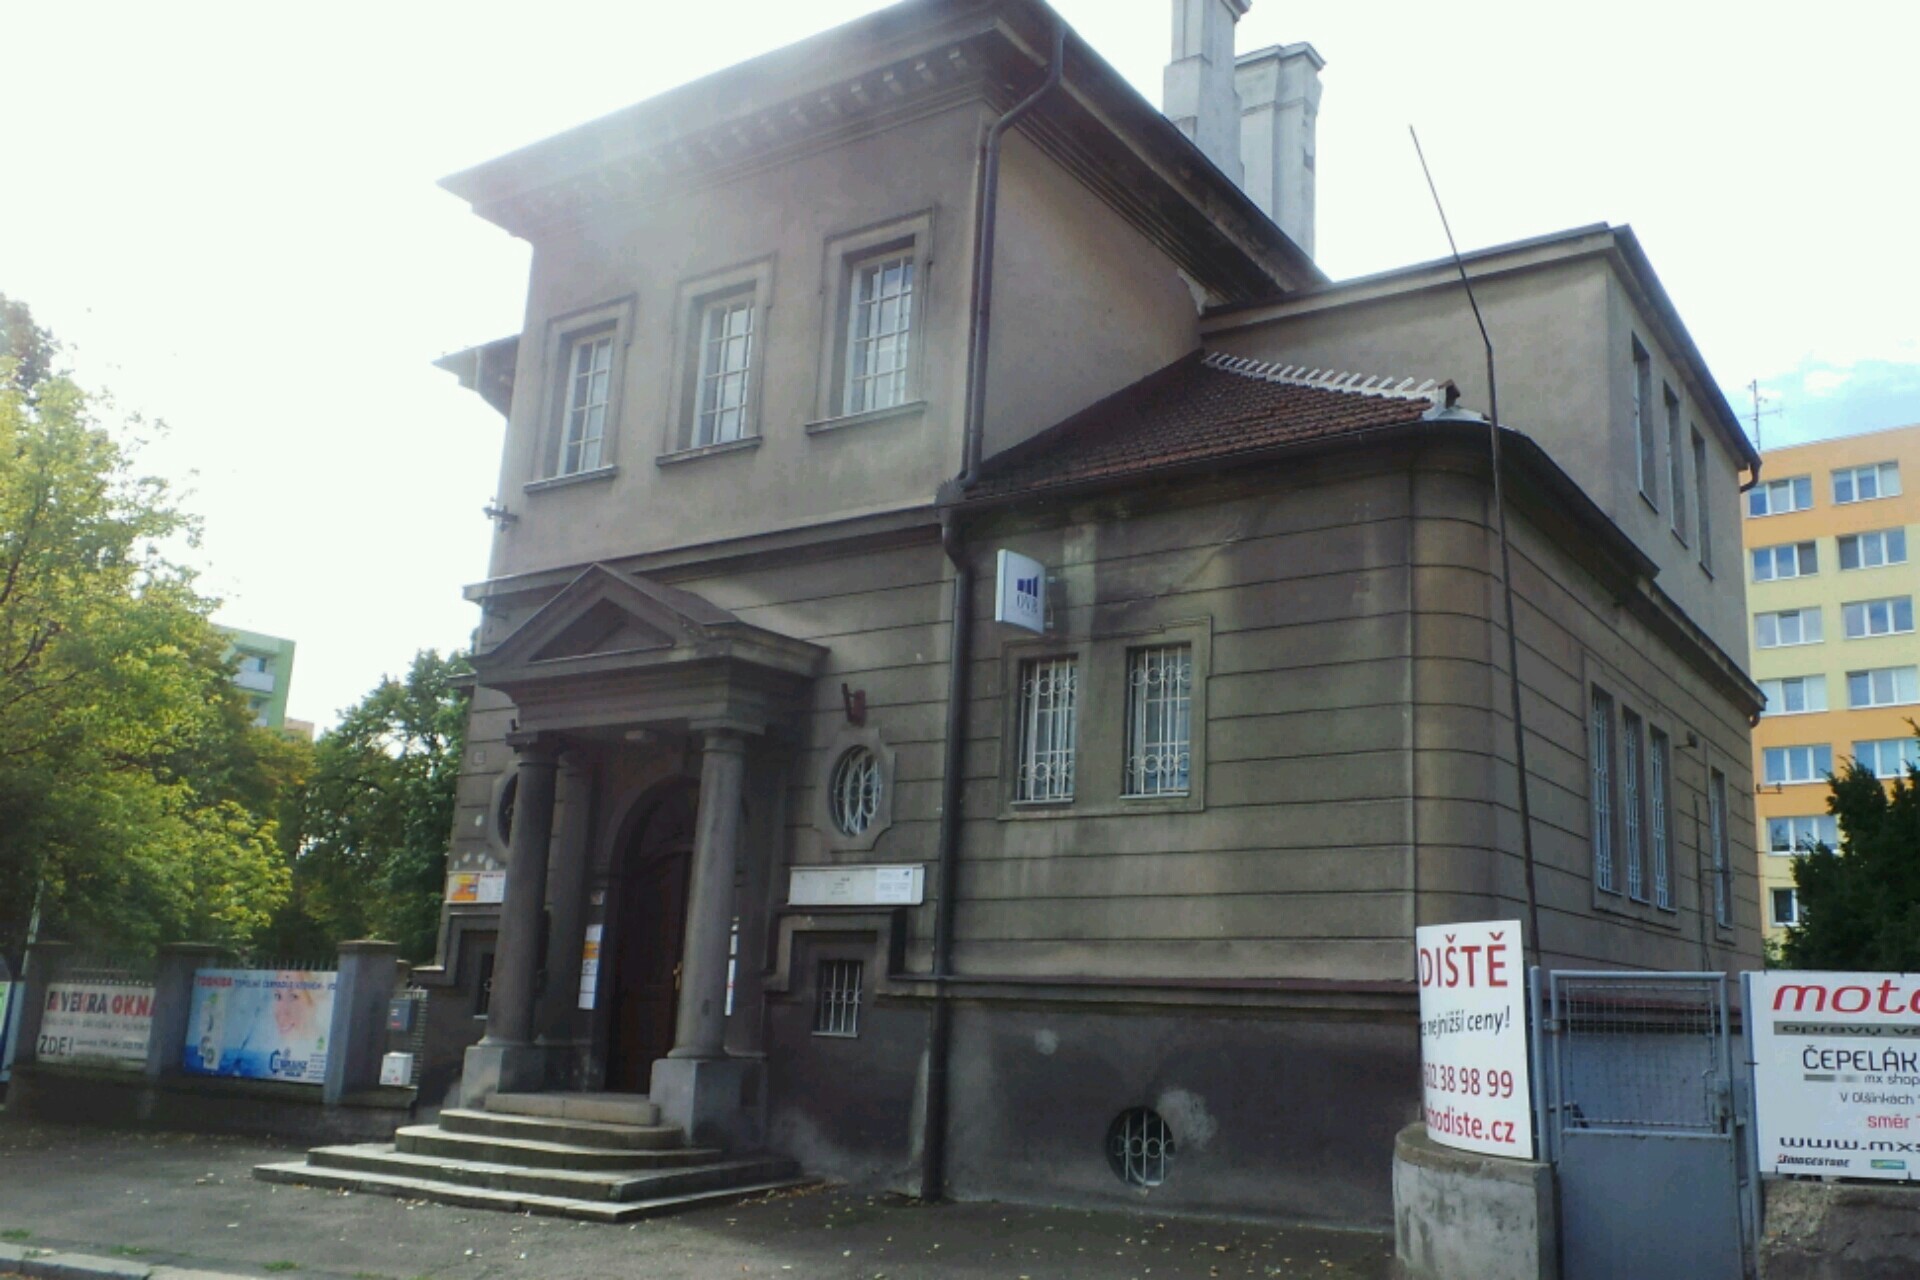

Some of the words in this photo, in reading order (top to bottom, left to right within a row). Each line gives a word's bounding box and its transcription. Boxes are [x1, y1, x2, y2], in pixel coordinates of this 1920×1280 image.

[1420, 931, 1508, 988] DIŠTĚ
[1772, 979, 1920, 1014] mot
[1467, 1005, 1511, 1035] ceny!
[1782, 1024, 1881, 1036] opravy
[39, 1034, 74, 1056] ZDE!
[1803, 1045, 1918, 1073] ČEPELÁK
[1440, 1064, 1456, 1093] 38
[1460, 1066, 1481, 1096] 98
[1487, 1069, 1514, 1099] 99
[1864, 1074, 1883, 1084] mx
[1868, 1114, 1911, 1130] směr
